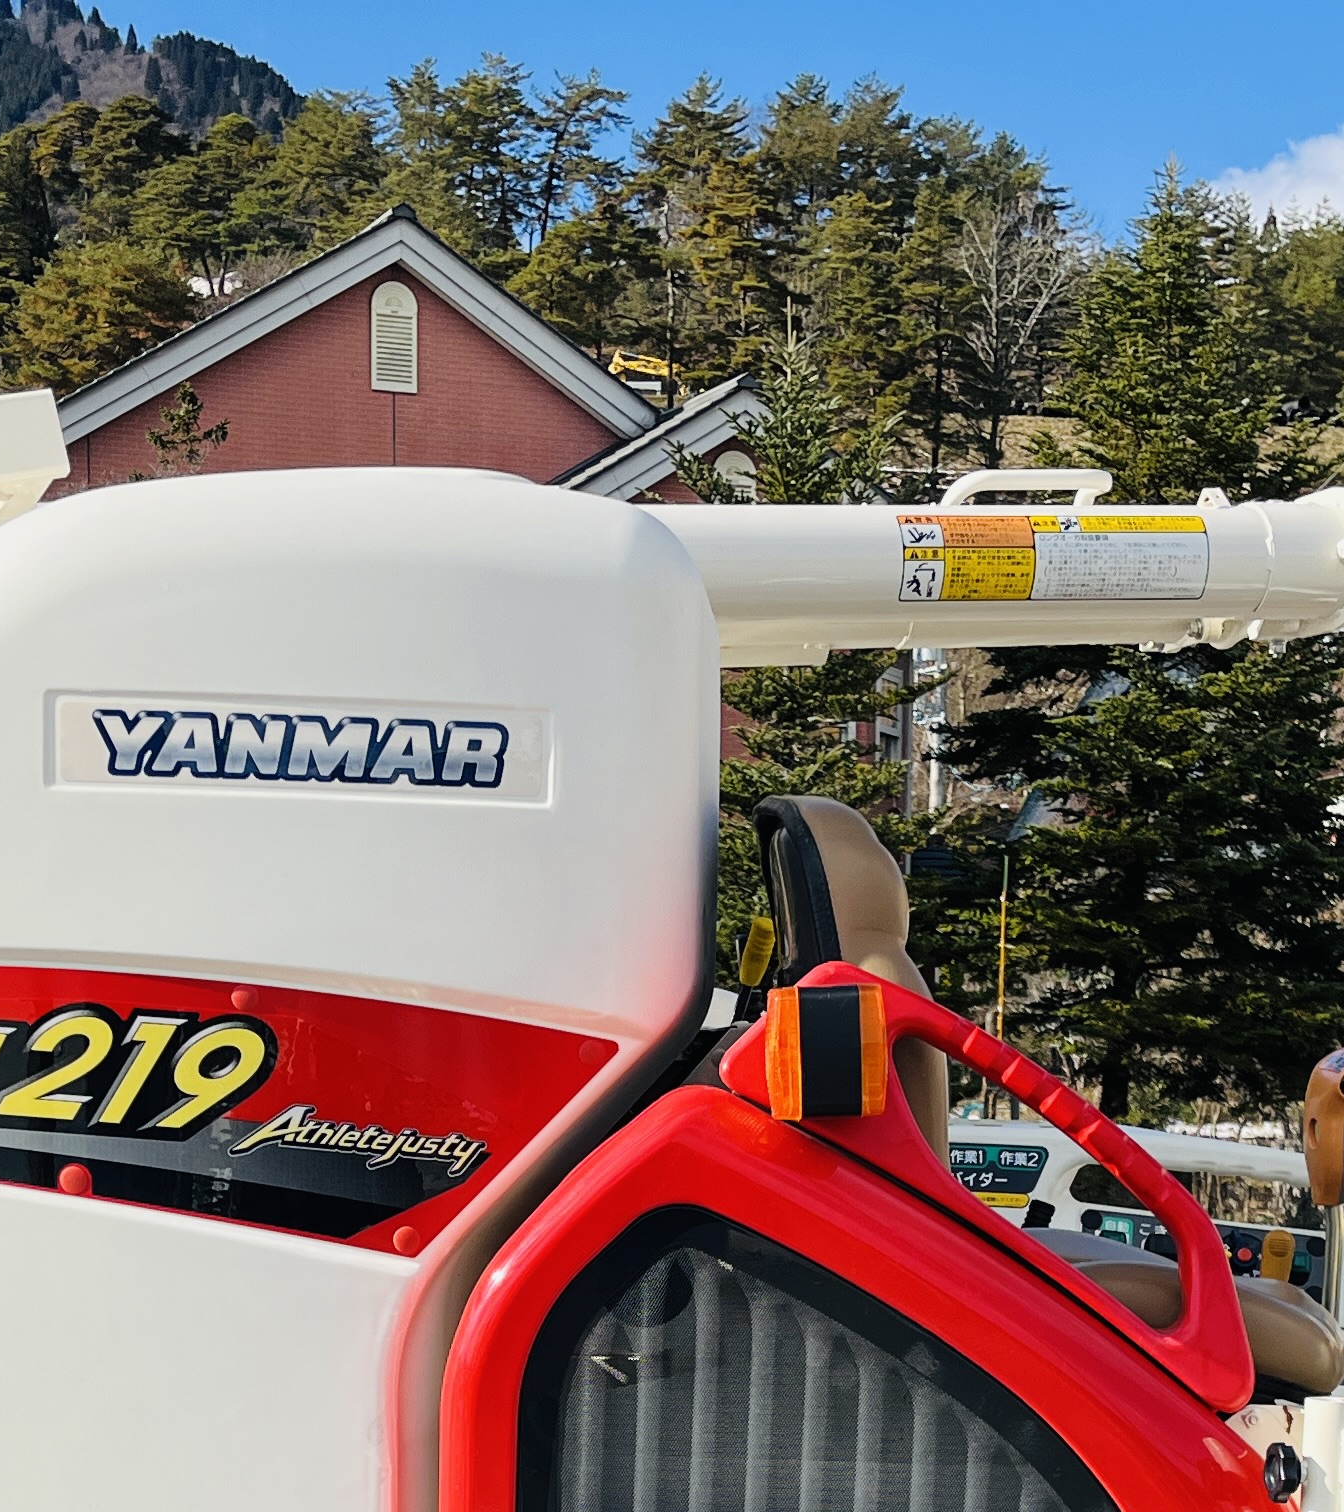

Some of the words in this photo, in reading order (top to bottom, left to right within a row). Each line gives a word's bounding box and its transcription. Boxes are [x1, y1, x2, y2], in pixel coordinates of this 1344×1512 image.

[93, 708, 509, 788] YANMAR
[231, 1105, 488, 1178] Athletejusty
[950, 1149, 983, 1164] 作業1
[1000, 1151, 1039, 1167] 作業2
